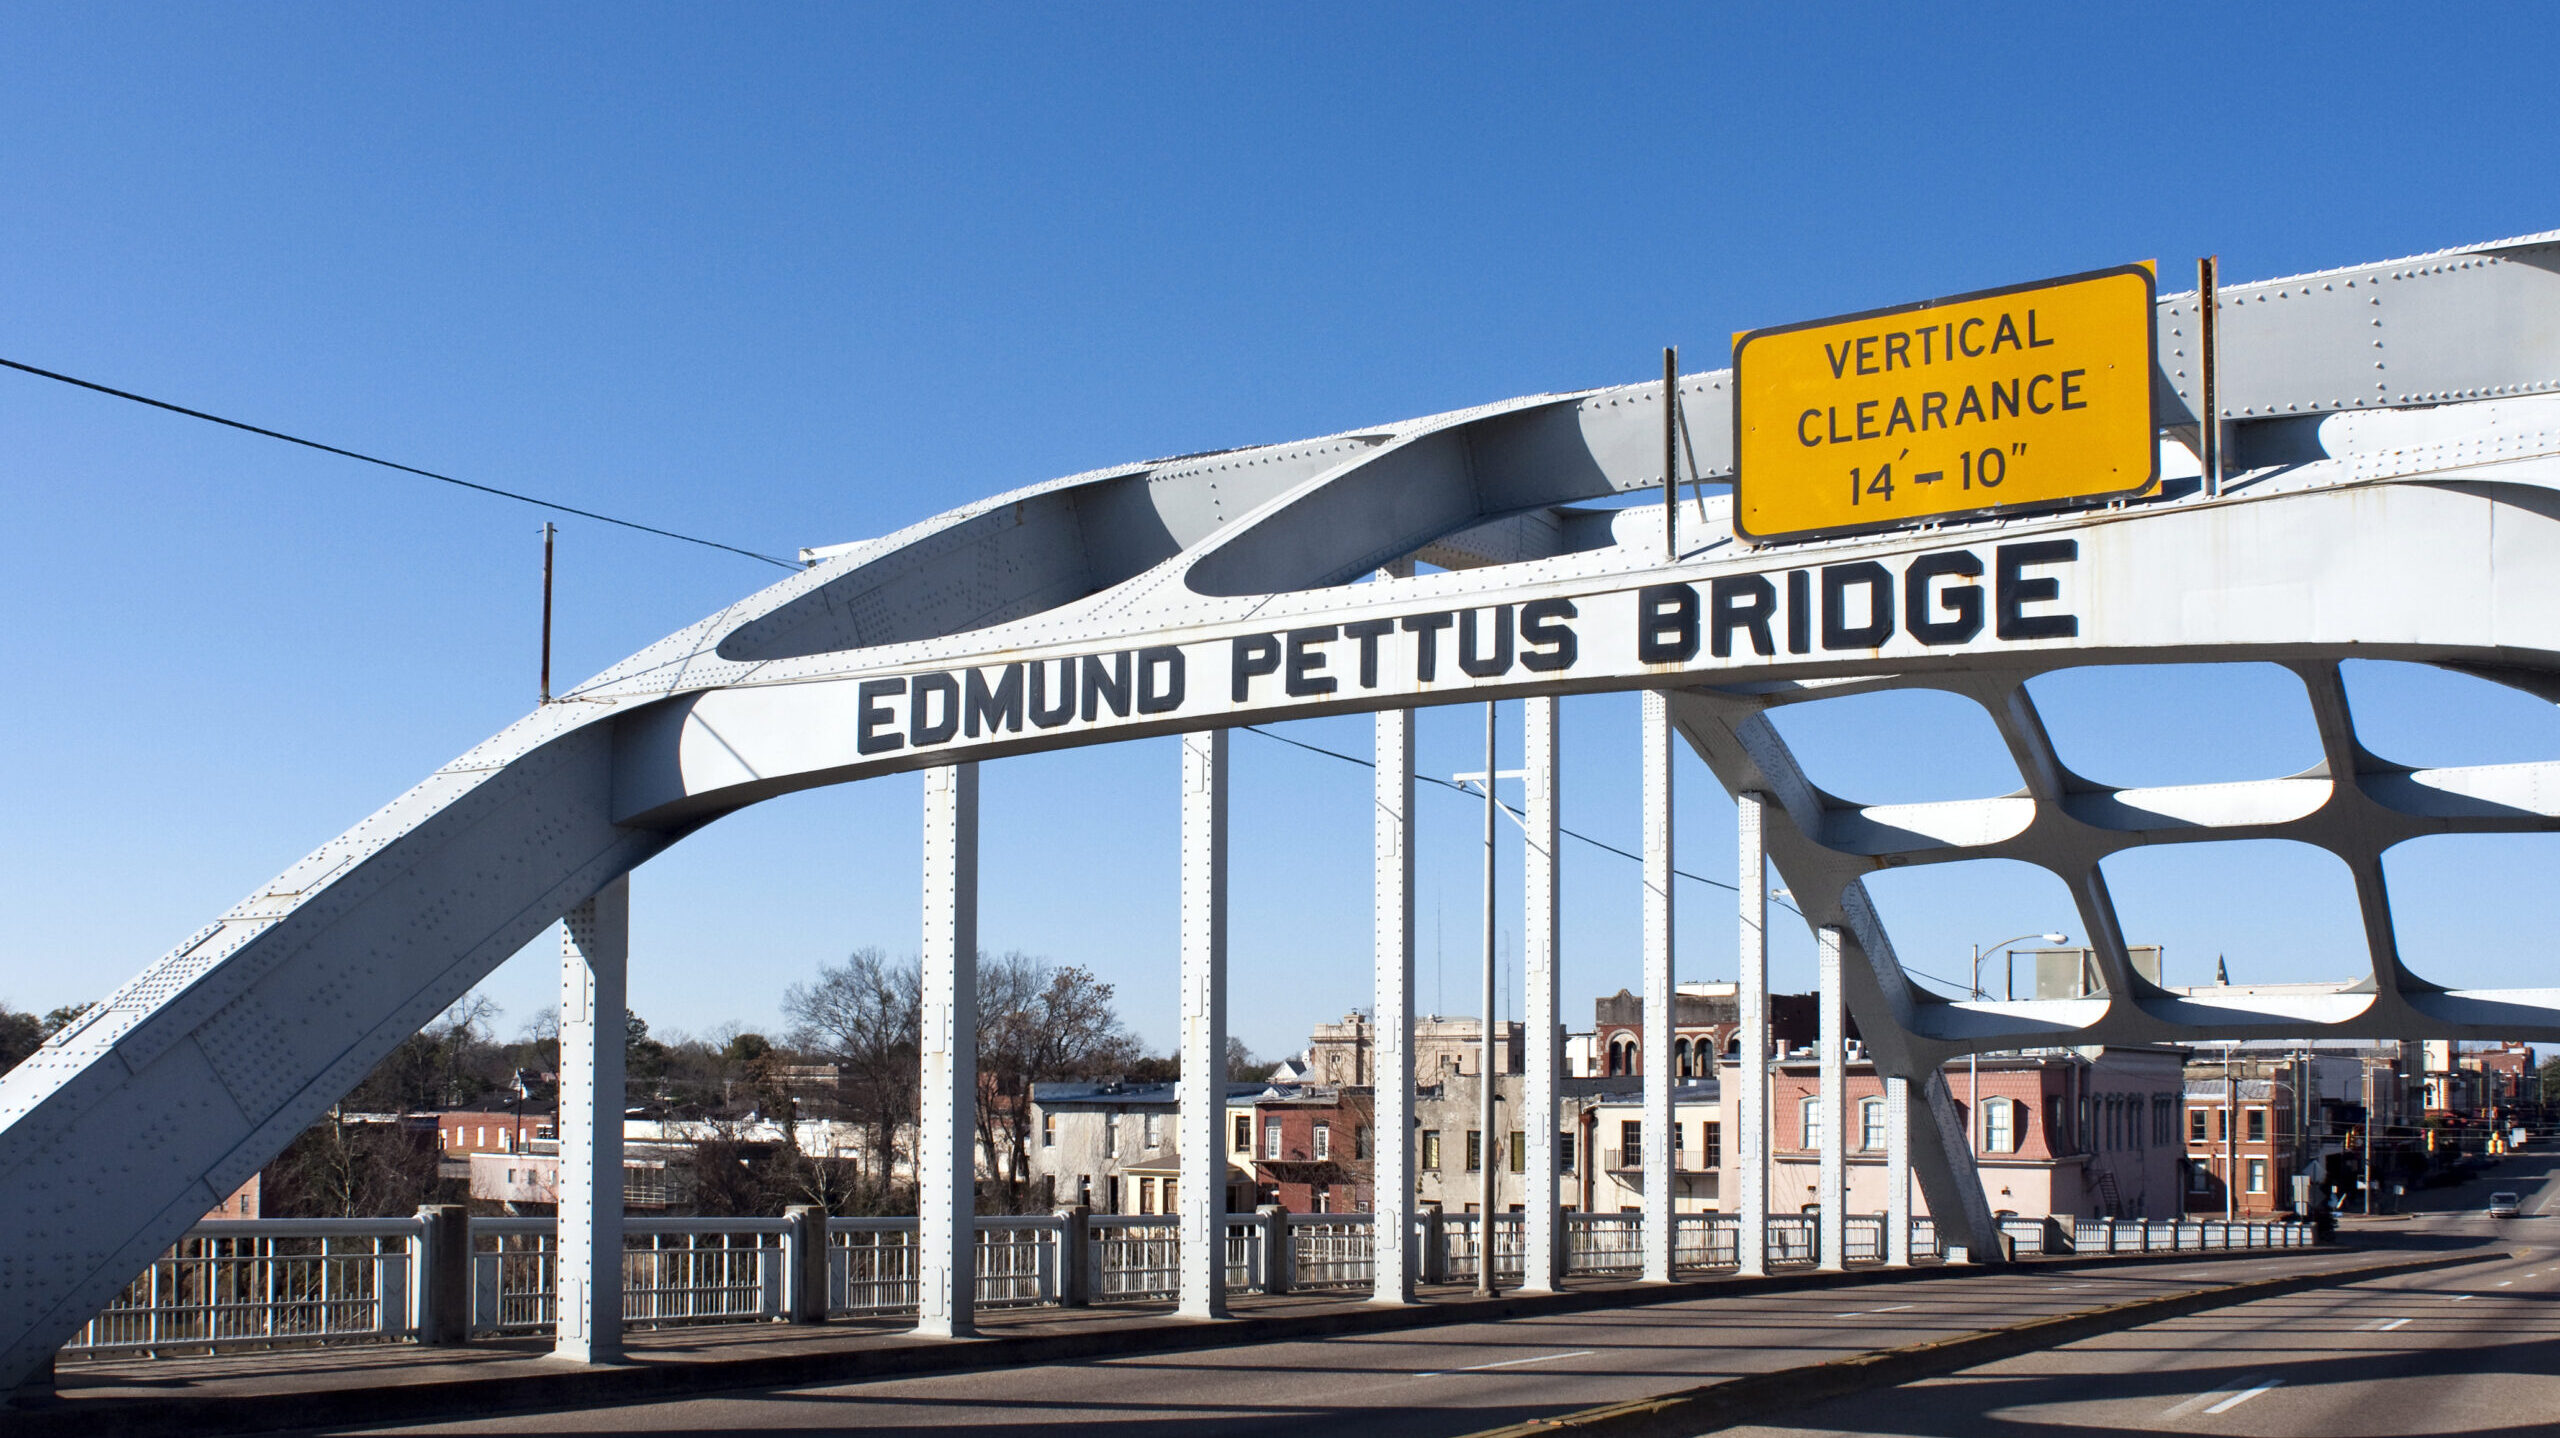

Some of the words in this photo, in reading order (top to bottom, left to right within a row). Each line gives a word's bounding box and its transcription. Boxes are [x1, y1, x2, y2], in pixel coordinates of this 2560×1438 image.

[1825, 309, 2054, 379] VERTICAL
[1798, 369, 2087, 447] CLEARANCE
[857, 644, 1186, 756] EDMUND
[1231, 598, 1579, 703] PETTUS
[1638, 539, 2078, 664] BRIDGE
